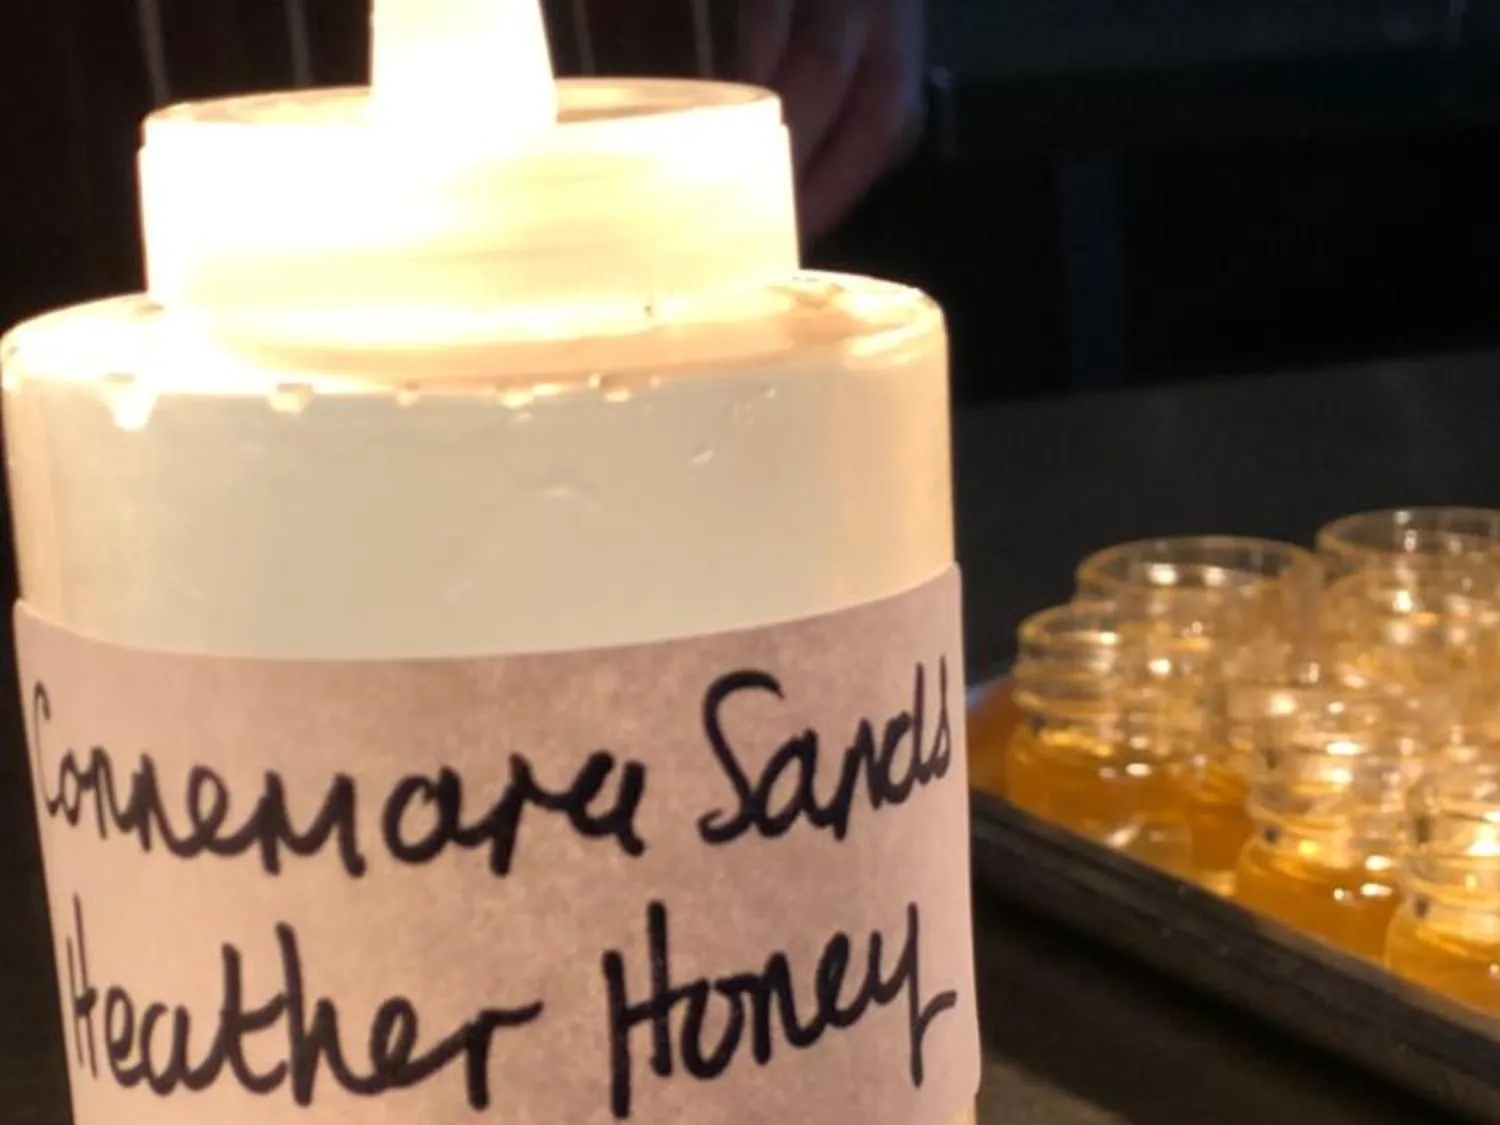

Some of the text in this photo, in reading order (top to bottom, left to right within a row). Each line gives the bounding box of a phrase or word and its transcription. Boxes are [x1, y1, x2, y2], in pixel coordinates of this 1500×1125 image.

[33, 653, 952, 877] Connemara Sands
[66, 893, 957, 1119] Heather Honey
